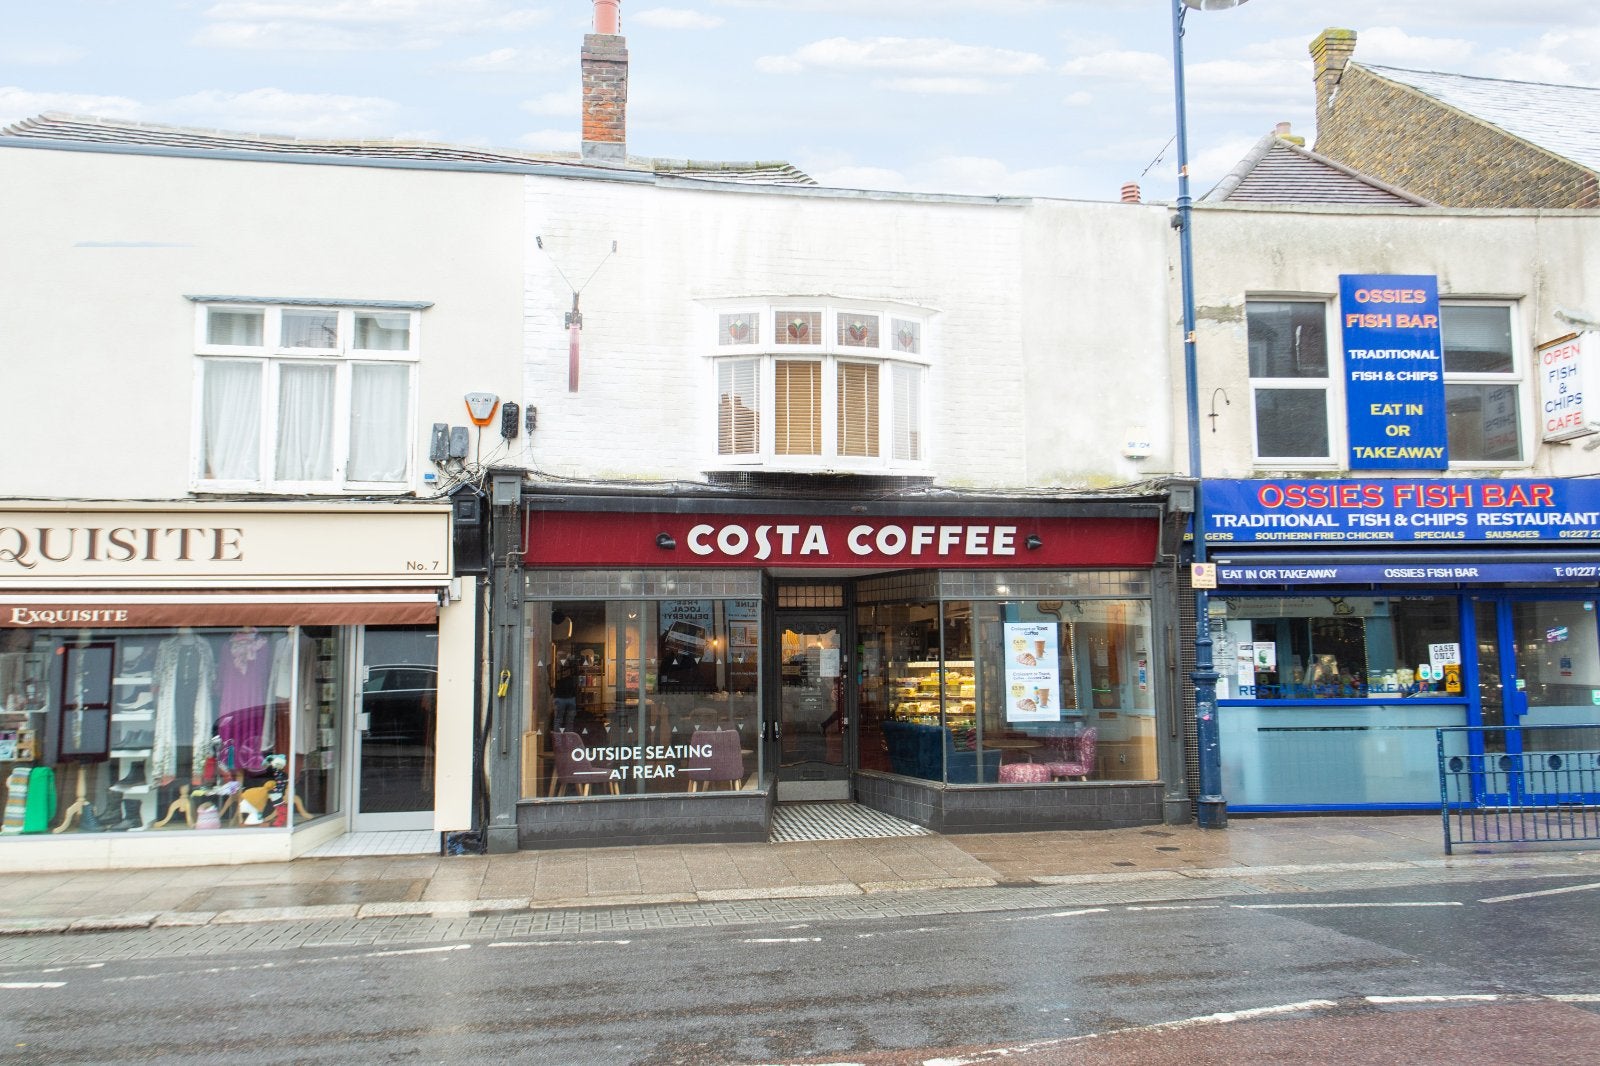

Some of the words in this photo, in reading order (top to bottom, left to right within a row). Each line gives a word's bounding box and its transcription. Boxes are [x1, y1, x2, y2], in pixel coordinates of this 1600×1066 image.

[1354, 288, 1426, 304] OSSIES
[1345, 313, 1392, 328] FISH
[1396, 313, 1438, 329] BAR
[1348, 349, 1440, 360] TRADITIONAL
[1543, 343, 1581, 365] OPEN
[1351, 371, 1384, 381] FISH
[1385, 371, 1395, 381] &
[1396, 371, 1438, 381] CHIPS
[1548, 363, 1577, 383] FISH
[1559, 382, 1567, 394] &
[1370, 403, 1403, 416] EAT
[1405, 404, 1424, 416] IN
[1544, 392, 1583, 413] CHIPS
[1546, 411, 1583, 432] CAFE
[1385, 424, 1411, 437] OR
[1352, 446, 1445, 459] TAKEAWAY
[1257, 483, 1385, 509] OSSIES
[1392, 483, 1474, 508] FISH
[1481, 483, 1557, 508] BAR
[1212, 514, 1340, 527] TRADITIONAL
[1347, 513, 1391, 527] FISH
[1393, 513, 1409, 527] &
[1410, 513, 1468, 526] CHIPS
[1476, 512, 1599, 526] RESTAURANT
[1254, 532, 1313, 540] SOUTHERN
[1314, 531, 1345, 540] FRIED
[1346, 531, 1394, 540] CHICKEN
[1413, 531, 1465, 540] SPECIALS
[1485, 531, 1540, 539] SAUSAGES
[1559, 530, 1590, 538] 01227
[0, 526, 245, 570] QUISITE
[686, 524, 829, 561] COSTA
[847, 524, 1017, 556] COFFEE
[406, 561, 428, 571] No.
[432, 561, 439, 571] 7
[1222, 569, 1243, 579] EAT
[1245, 569, 1257, 579] IN
[1259, 569, 1277, 579] OR
[1278, 569, 1337, 579] TAKEAWAY
[1384, 568, 1425, 578] OSSIES
[1426, 568, 1453, 578] FISH
[1454, 567, 1479, 577] BAR
[1565, 566, 1597, 577] 01227
[1433, 644, 1455, 653] CASH
[1434, 652, 1455, 660] ONLY
[571, 747, 642, 762] OUTSIDE
[645, 744, 713, 760] SEATING
[609, 766, 630, 780] AT
[633, 764, 676, 779] REAR
